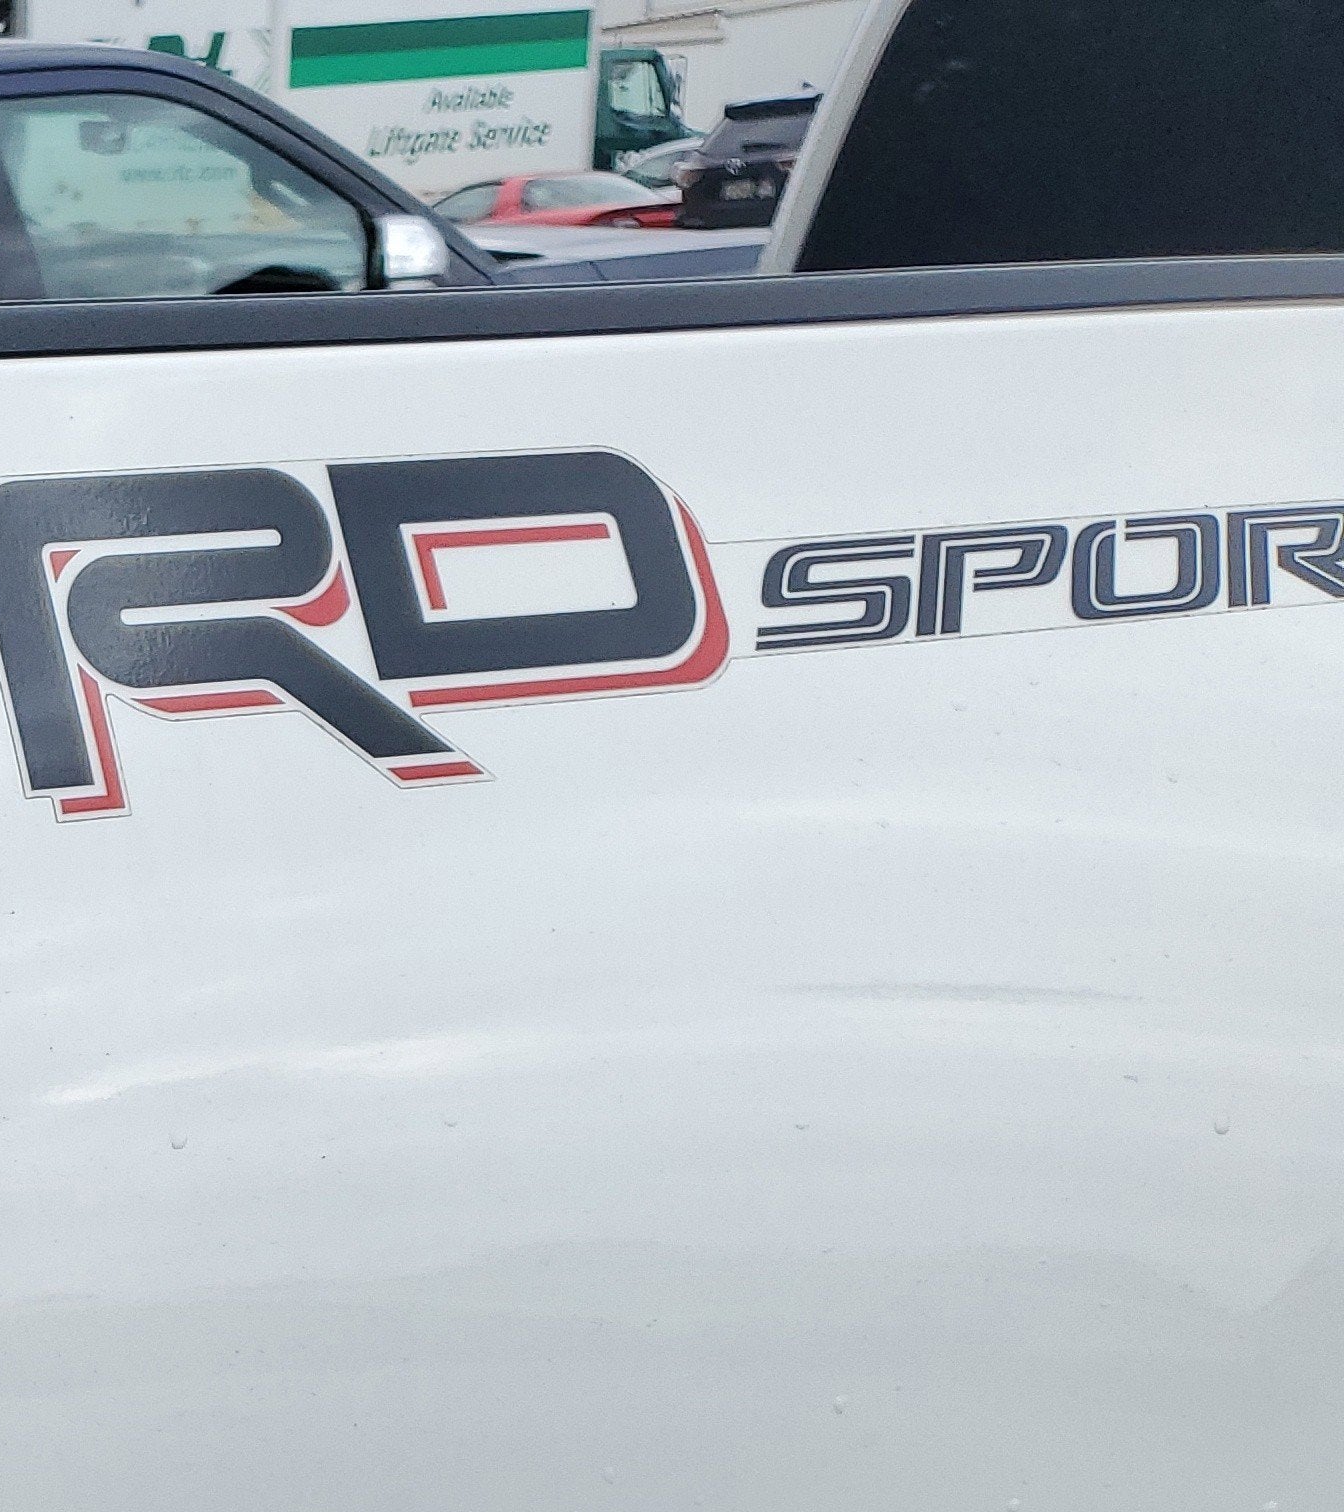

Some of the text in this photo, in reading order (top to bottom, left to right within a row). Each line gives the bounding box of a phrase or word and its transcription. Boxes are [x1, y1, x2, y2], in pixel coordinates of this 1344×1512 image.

[423, 82, 515, 113] Available
[367, 115, 551, 165] Liftgate Service
[755, 505, 1344, 652] SPOR
